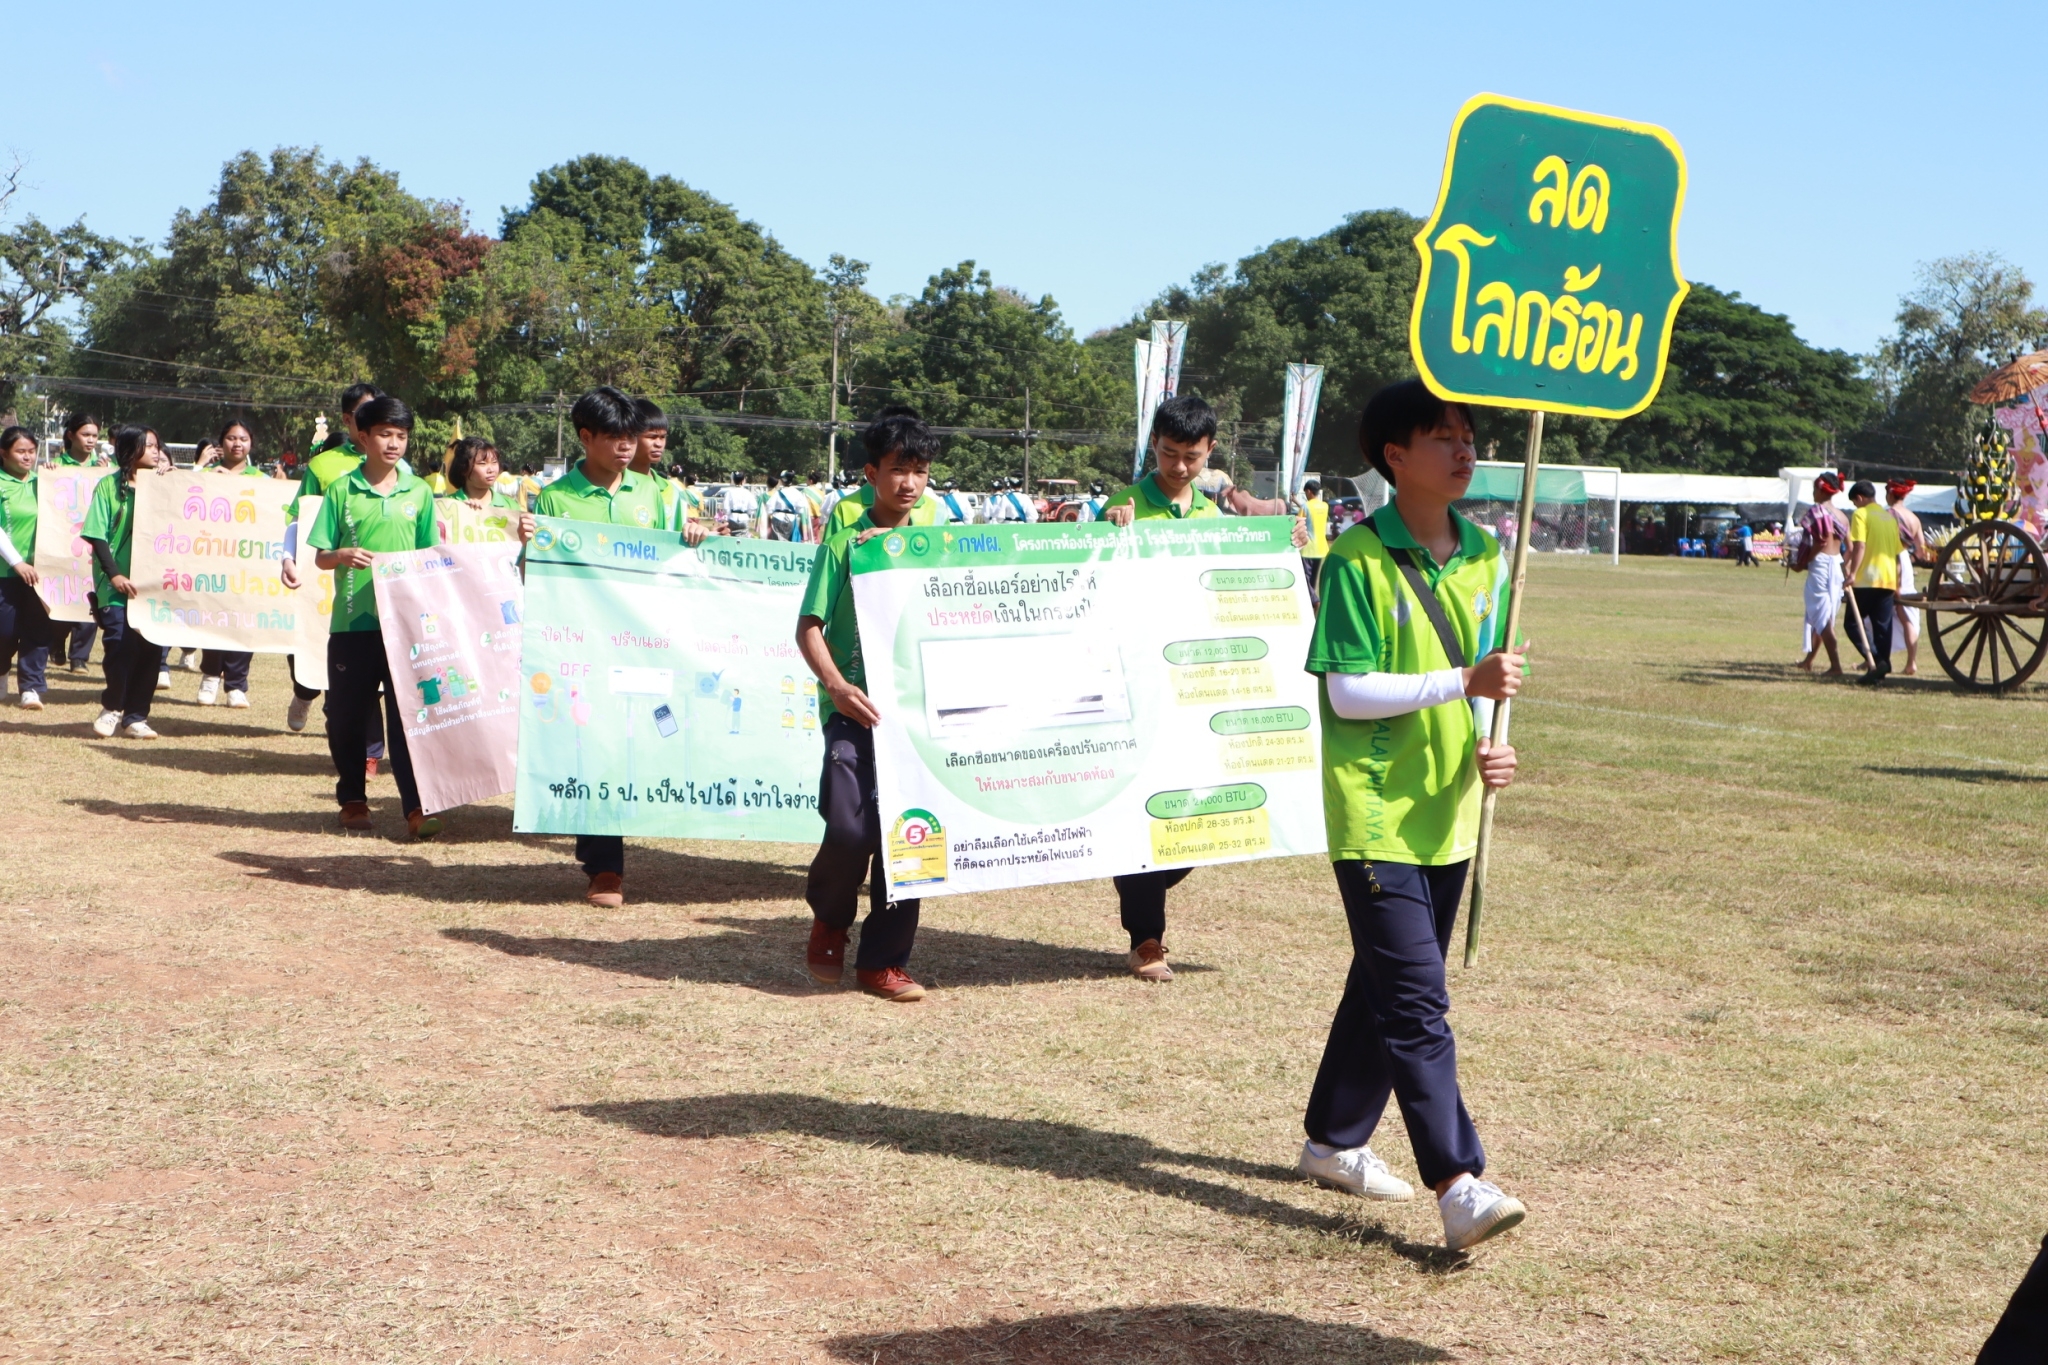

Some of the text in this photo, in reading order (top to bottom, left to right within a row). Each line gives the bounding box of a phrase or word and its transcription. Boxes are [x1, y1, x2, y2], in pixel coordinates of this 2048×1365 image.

[1528, 154, 1610, 234] ลด
[1434, 223, 1643, 381] โลกร้อน
[183, 486, 257, 524] คิดดี
[613, 540, 660, 562] กฟผ.
[957, 533, 1002, 553] กฟผ.
[1257, 574, 1275, 583] BTU
[927, 598, 1096, 627] ประหยัดเงินในกระเป๋
[541, 626, 584, 643] ปิดไฟ
[611, 627, 671, 649] ปรับแอร์
[1230, 644, 1249, 655] BTU
[560, 661, 592, 678] OFF
[1276, 713, 1295, 723] BTU
[945, 738, 1138, 768] เลือกซือขนาดของเครื่องปรับอากาศ
[974, 766, 1115, 793] ให้เหมาะสมกับขนาดห้อง
[549, 777, 591, 801] หลัก
[598, 782, 610, 801] 5
[617, 782, 639, 802] ป.
[646, 777, 736, 807] เป็นไปได้
[1164, 799, 1189, 810] ขนาด
[1225, 790, 1247, 803] BTU
[909, 827, 922, 844] 5
[1165, 818, 1204, 834] ห้องปกติ
[1206, 818, 1231, 829] 28-35
[953, 826, 1093, 853] อย่าลืมเลือกใช้เครื่องใช้ไฟฟ้า
[1157, 842, 1216, 858] ห้องโดนแดด
[1218, 839, 1242, 851] 25-32
[953, 844, 1085, 871] ที่ติดฉลากประหยัดไฟเบอร์
[1087, 848, 1093, 857] 5
